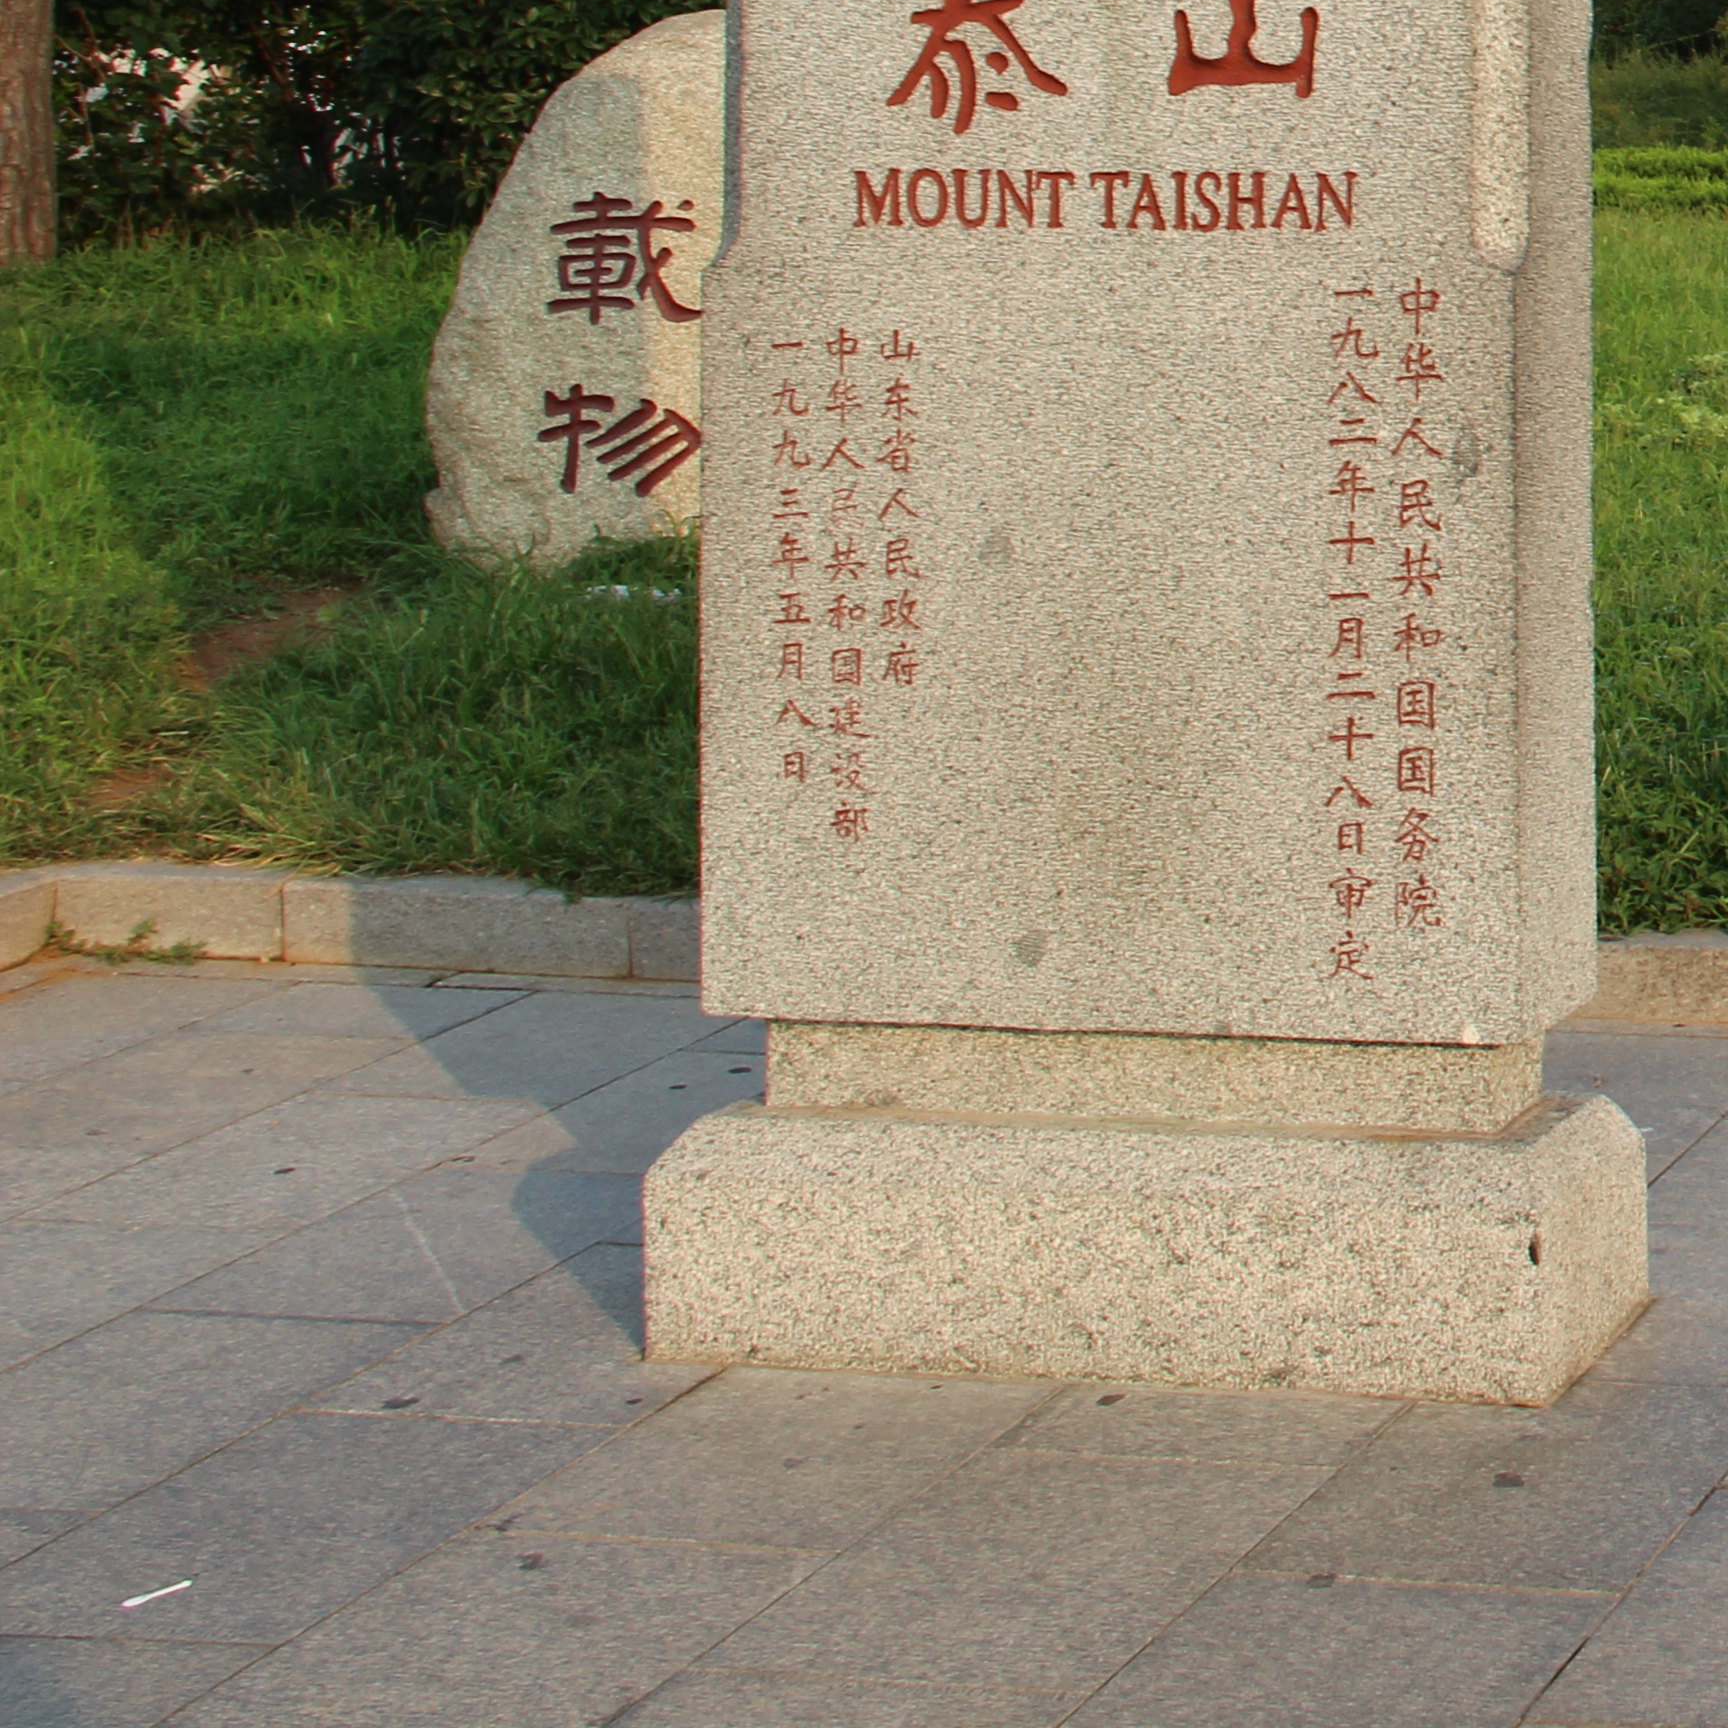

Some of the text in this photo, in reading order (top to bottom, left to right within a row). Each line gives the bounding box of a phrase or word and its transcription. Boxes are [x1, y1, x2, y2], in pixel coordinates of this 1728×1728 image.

[852, 168, 1361, 233] MOUNT TAISHAN
[771, 340, 817, 785] 一九九三年五月八日
[821, 326, 877, 844] 中华人民共和国建设部
[877, 329, 923, 686] 山东省人民政府
[1325, 286, 1380, 980] 一九八二年十一月二十八日审定
[1391, 276, 1445, 928] 中华人民共和国国务院
